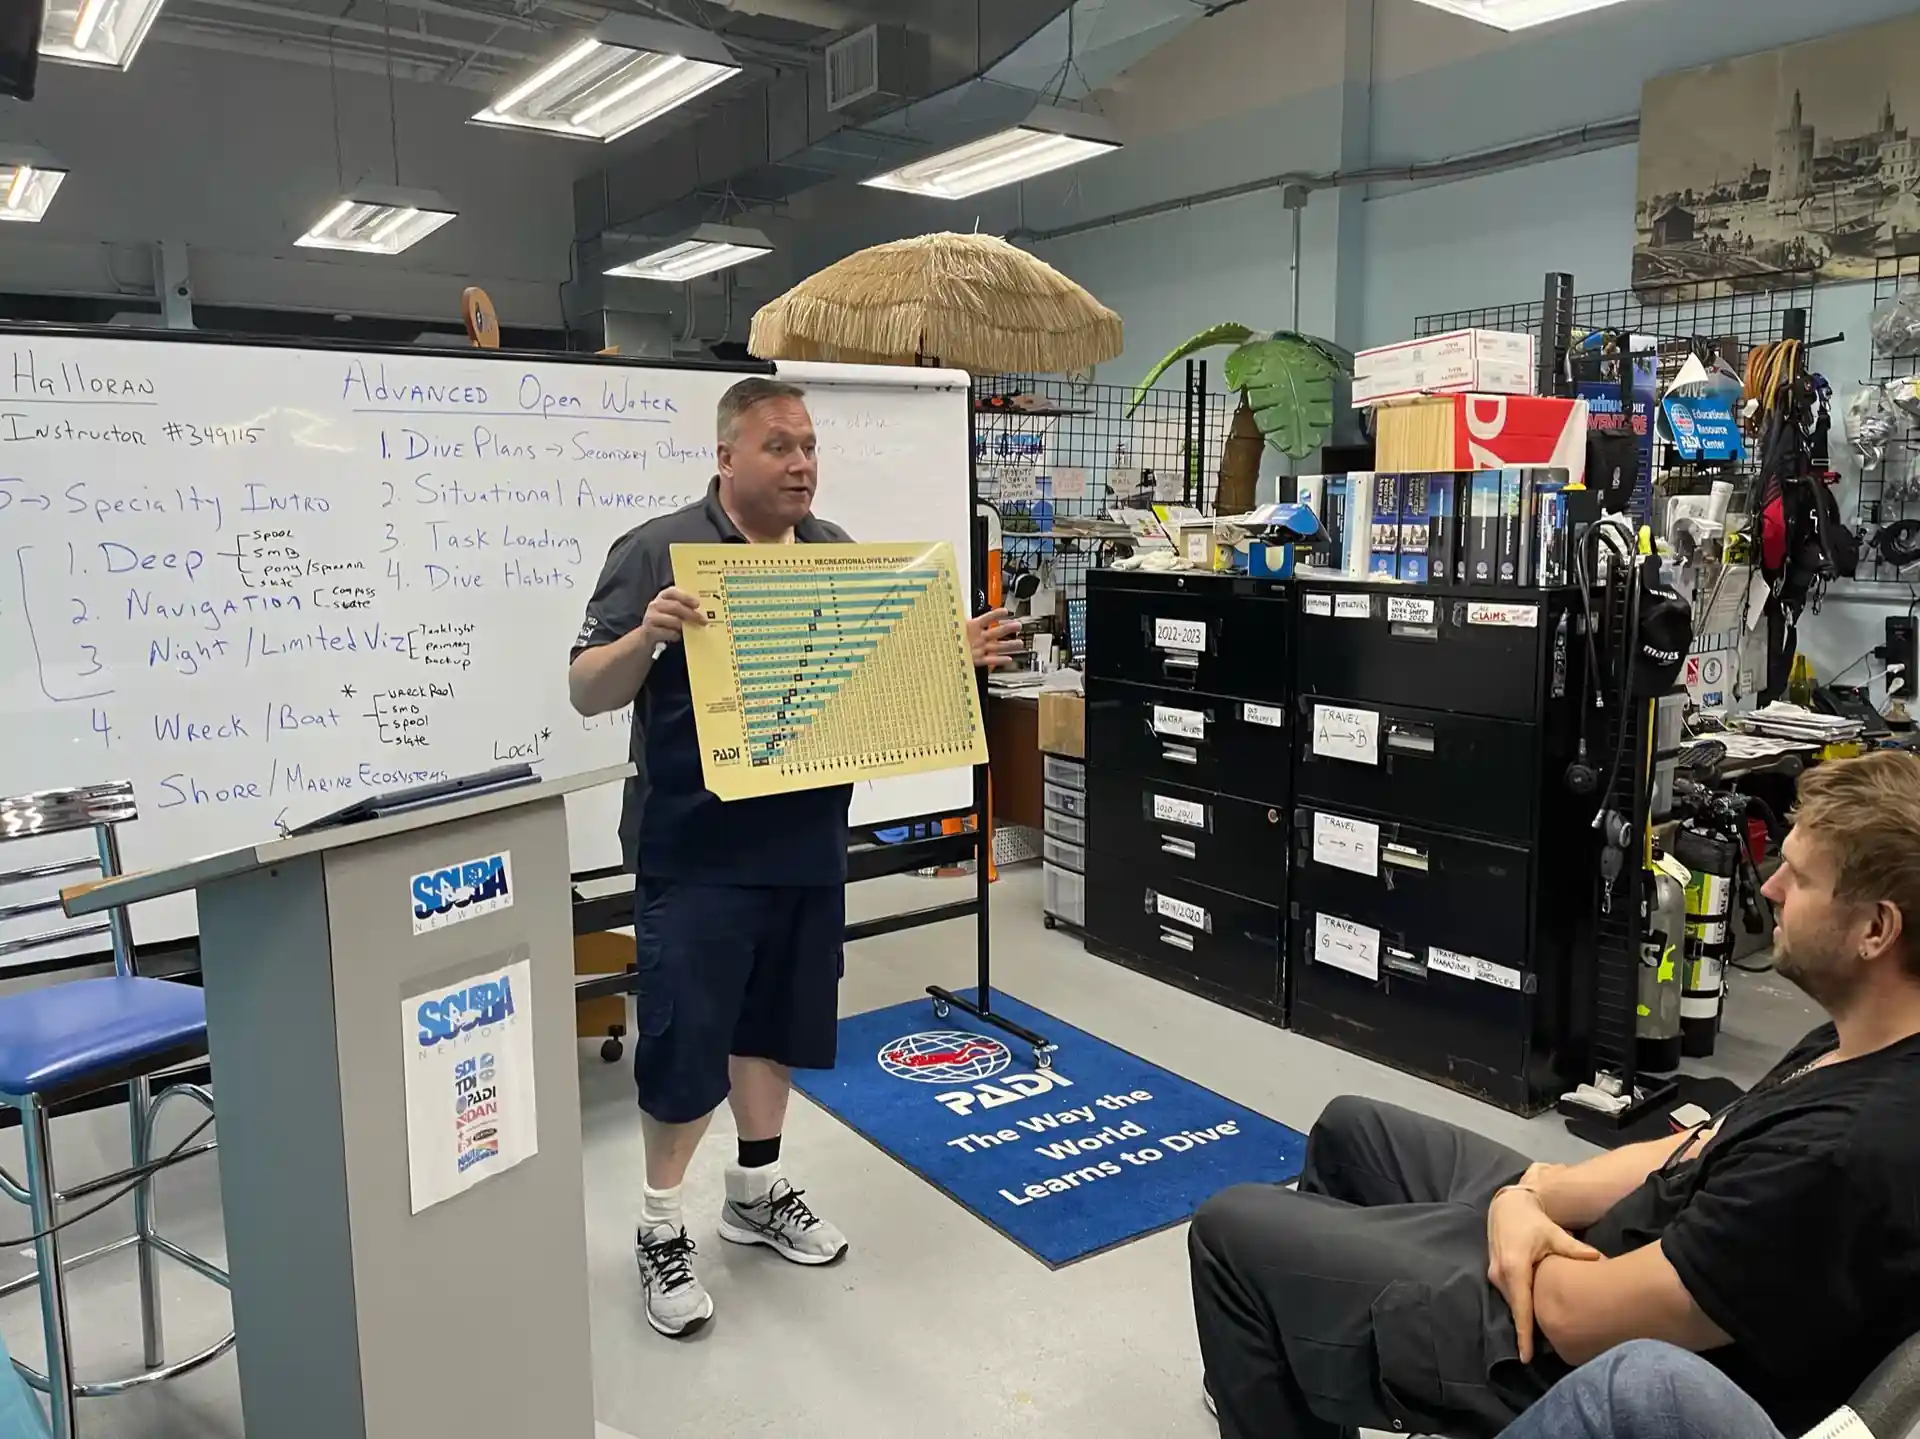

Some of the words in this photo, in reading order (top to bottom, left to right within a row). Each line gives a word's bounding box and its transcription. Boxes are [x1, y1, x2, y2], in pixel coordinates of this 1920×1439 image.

[518, 373, 582, 419] Open
[163, 421, 266, 446] #349115
[474, 426, 536, 459] Plans
[1702, 438, 1725, 449] Center
[415, 473, 563, 505] Situational
[65, 483, 223, 531] Specialty
[423, 521, 490, 551] Task
[503, 525, 582, 564] Loading
[99, 542, 203, 582] Deep
[814, 558, 867, 566] RECREATIONAL
[386, 557, 410, 591] 4.
[424, 564, 484, 591] Dive
[504, 560, 575, 588] Habits
[1471, 611, 1507, 622] CLAIMS
[1157, 625, 1201, 644] 2022-2023
[1643, 645, 1680, 660] mares
[1320, 708, 1361, 725] TRAVEL
[1318, 726, 1330, 744] A
[1355, 729, 1367, 748] B
[712, 747, 740, 762] PADI
[1322, 816, 1356, 833] TRAVEL
[414, 896, 511, 933] NETWORK
[1323, 916, 1359, 937] TRAVEL
[1358, 944, 1371, 962] Z
[1435, 949, 1461, 962] TRAVEL
[467, 1085, 497, 1107] PADI
[934, 1067, 1074, 1117] PADI
[467, 1102, 498, 1123] DAN
[946, 1126, 1021, 1154] The
[1016, 1104, 1099, 1134] Way
[1095, 1088, 1154, 1112] the
[1034, 1119, 1148, 1162] World
[999, 1157, 1122, 1208] Learns
[1120, 1146, 1164, 1166] to
